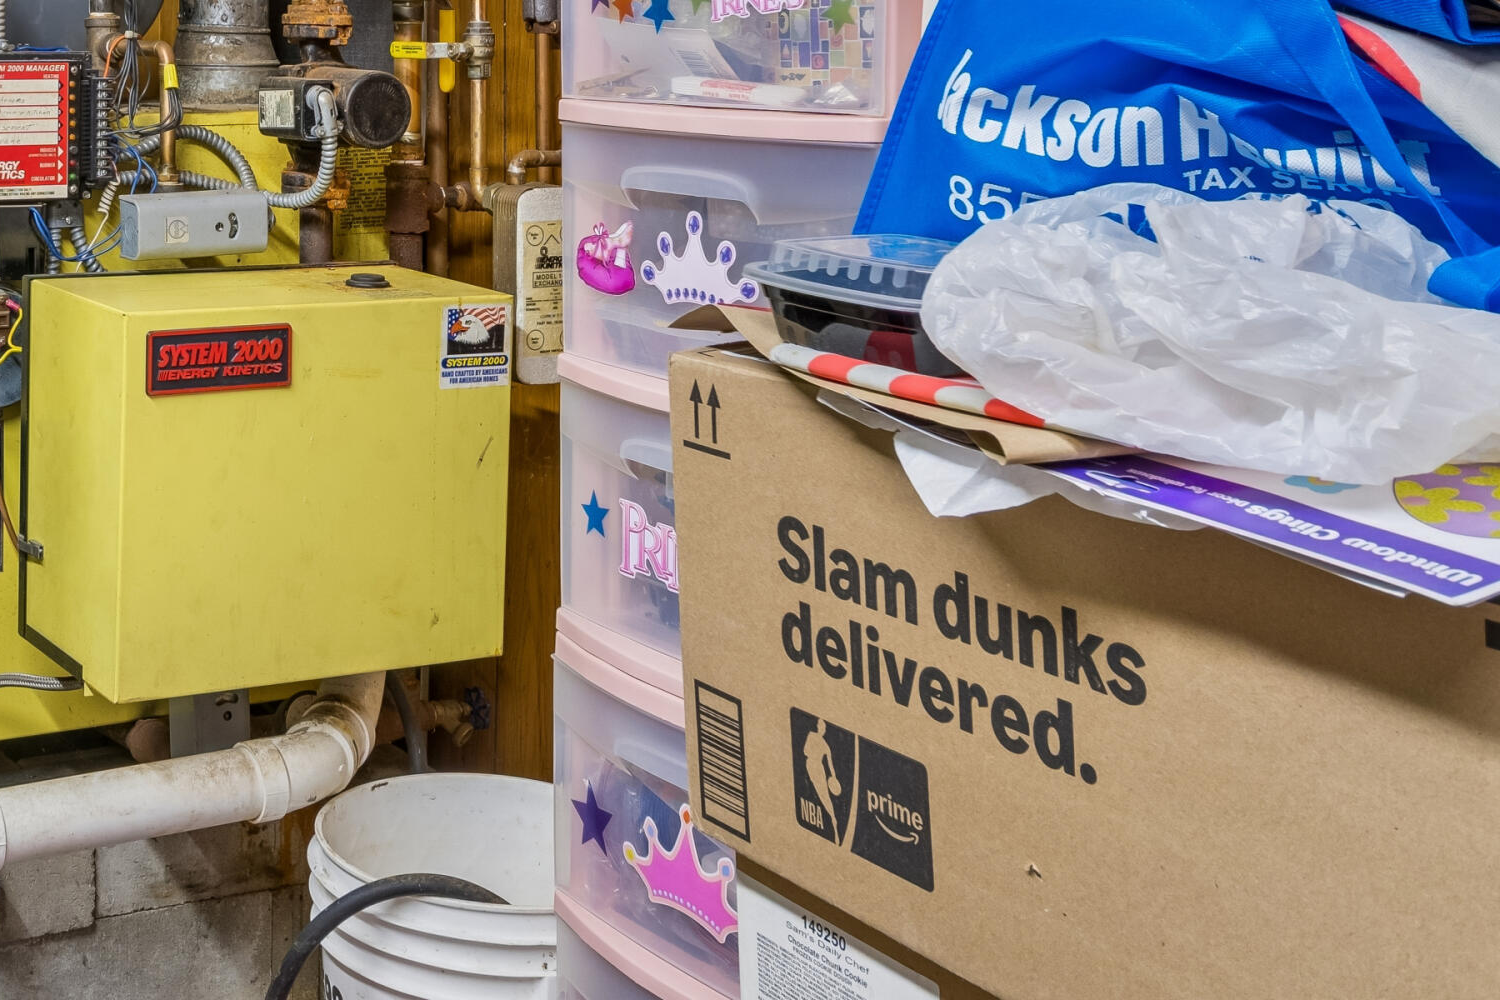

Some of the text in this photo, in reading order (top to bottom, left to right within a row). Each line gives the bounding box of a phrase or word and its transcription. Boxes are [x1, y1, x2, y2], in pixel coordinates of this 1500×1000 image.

[7, 64, 25, 72] 2000
[26, 64, 66, 72] MANAGER
[1182, 166, 1257, 193] TAX
[948, 174, 1053, 224] 85
[157, 337, 284, 368] SYSTEM 2000
[446, 356, 506, 367] SYSTEM 2000
[167, 362, 283, 381] ENERGY KINETICS
[454, 369, 475, 377] CRAFTED
[482, 367, 508, 375] AMERICANS
[459, 376, 482, 384] AMERICAN
[1241, 499, 1484, 587] Window Clings
[777, 515, 1148, 707] Slam dunks
[781, 600, 1098, 785] delivered.
[799, 797, 825, 830] NBA
[866, 788, 924, 832] prime
[786, 920, 870, 975] Sam's Daily Chef
[801, 915, 847, 951] 149250
[787, 934, 869, 989] Chocolate Chunk Cookie
